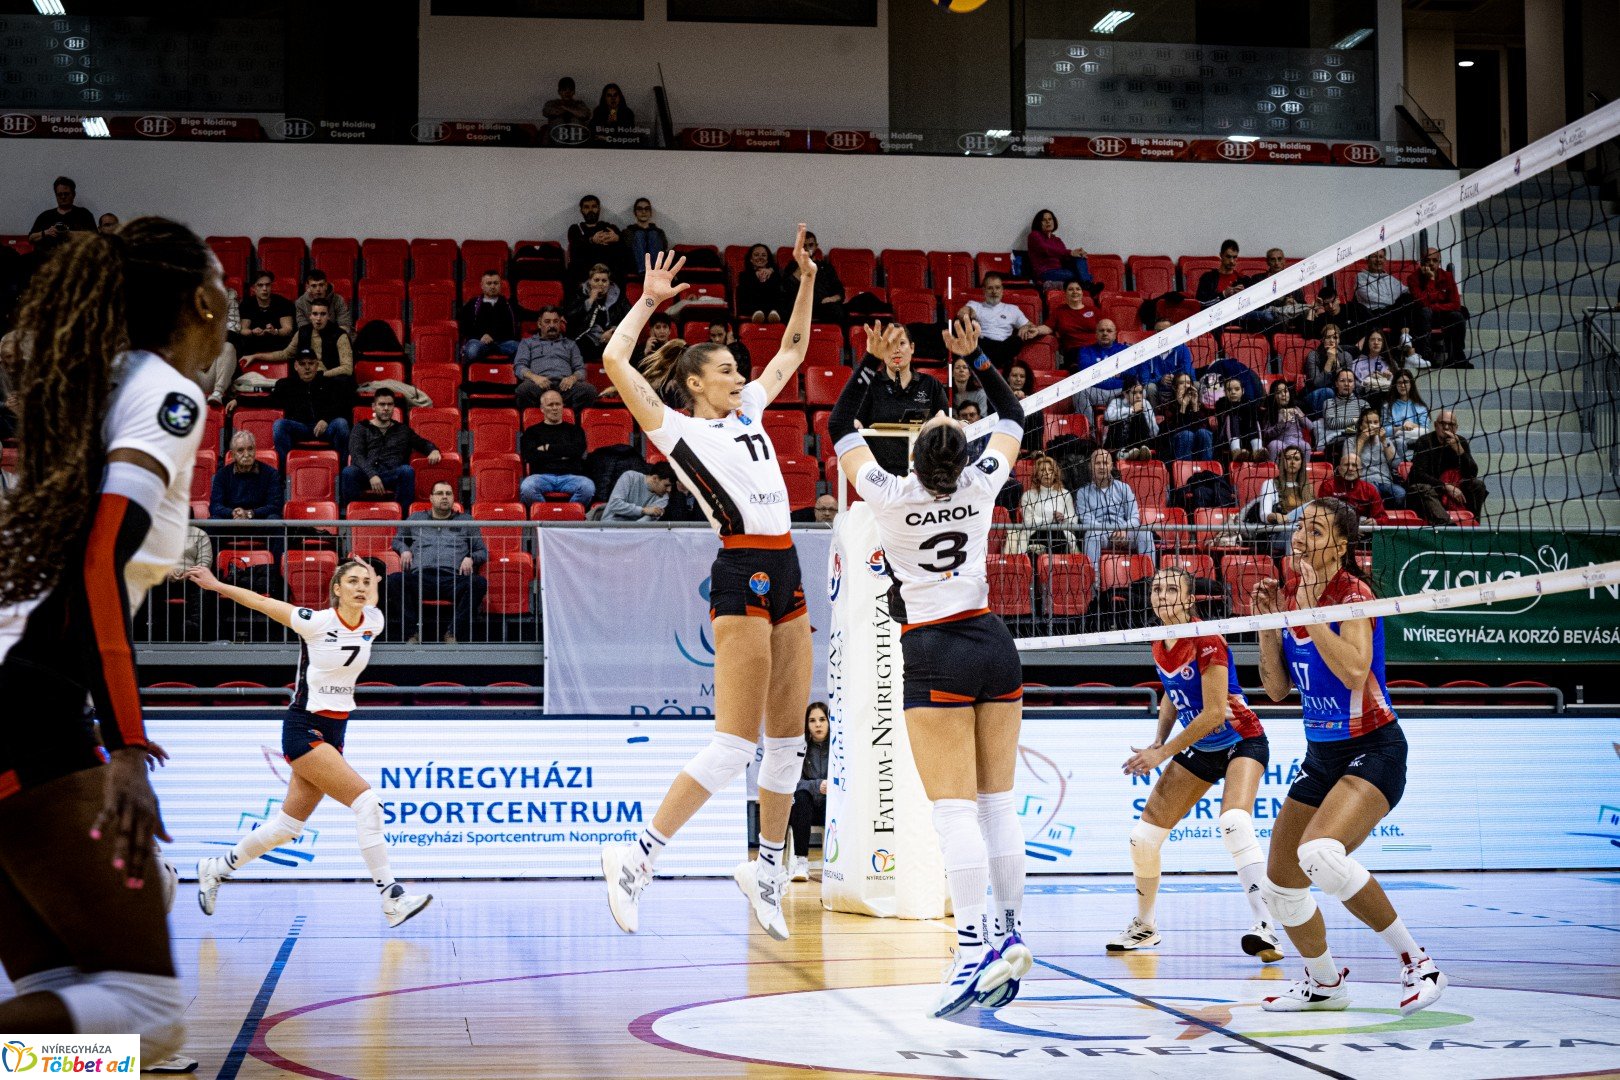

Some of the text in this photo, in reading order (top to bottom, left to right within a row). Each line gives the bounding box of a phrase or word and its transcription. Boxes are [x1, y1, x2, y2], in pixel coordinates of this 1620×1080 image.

[69, 40, 84, 48] BH
[1070, 48, 1085, 56] BH
[1327, 57, 1341, 65] BH
[1056, 63, 1071, 72] BH
[1084, 63, 1099, 72] BH
[68, 74, 83, 82] BH
[1312, 72, 1327, 80] BH
[1341, 73, 1355, 81] BH
[84, 91, 99, 100] BH
[1271, 87, 1285, 95] BH
[1328, 88, 1341, 97] BH
[1027, 96, 1042, 104] BH
[1257, 103, 1271, 111] BH
[1285, 104, 1299, 112] BH
[3, 118, 29, 131] BH
[41, 115, 59, 124] Bige
[181, 118, 237, 128] Bige Holding
[51, 125, 84, 134] Csopor
[143, 119, 169, 133] BH
[282, 122, 308, 137] BH
[320, 120, 376, 130] Bige Holding
[595, 125, 650, 135] Bige Holding
[191, 128, 227, 137] Csoport
[330, 130, 366, 139] Csoport
[558, 127, 584, 141] BH
[699, 130, 724, 144] BH
[736, 129, 791, 139] Bige Holding
[606, 135, 640, 144] Csoport
[746, 138, 781, 148] Csoport
[833, 132, 858, 147] BH
[965, 137, 989, 150] BH
[1002, 135, 1054, 144] Bige Holding
[1131, 137, 1184, 148] Bige Holding
[1012, 143, 1045, 153] Csoport
[1096, 139, 1120, 153] BH
[1223, 142, 1249, 157] BH
[1259, 141, 1311, 152] Bige Holding
[1386, 145, 1437, 156] Bige Holding
[1140, 148, 1174, 157] Csoport
[1269, 151, 1302, 161] Csoport
[1351, 145, 1375, 160] BH
[1395, 155, 1428, 164] Csoport
[905, 504, 980, 526] CAROL
[917, 531, 969, 573] 3
[1403, 625, 1620, 644] NYÍREGYHÁZA KORZÓ BEVÁSÁ
[340, 646, 361, 667] 7
[1292, 661, 1310, 691] 17
[1169, 689, 1191, 710] 21
[381, 761, 593, 789] NYÍREGYHÁZI
[383, 801, 643, 825] SPORTCENTRUM
[1380, 824, 1404, 837] Kft.
[384, 830, 638, 847] Nyíregyházi Sportcentrum Nonprofit
[896, 1038, 1620, 1060] NYÍREGYHÁZA
